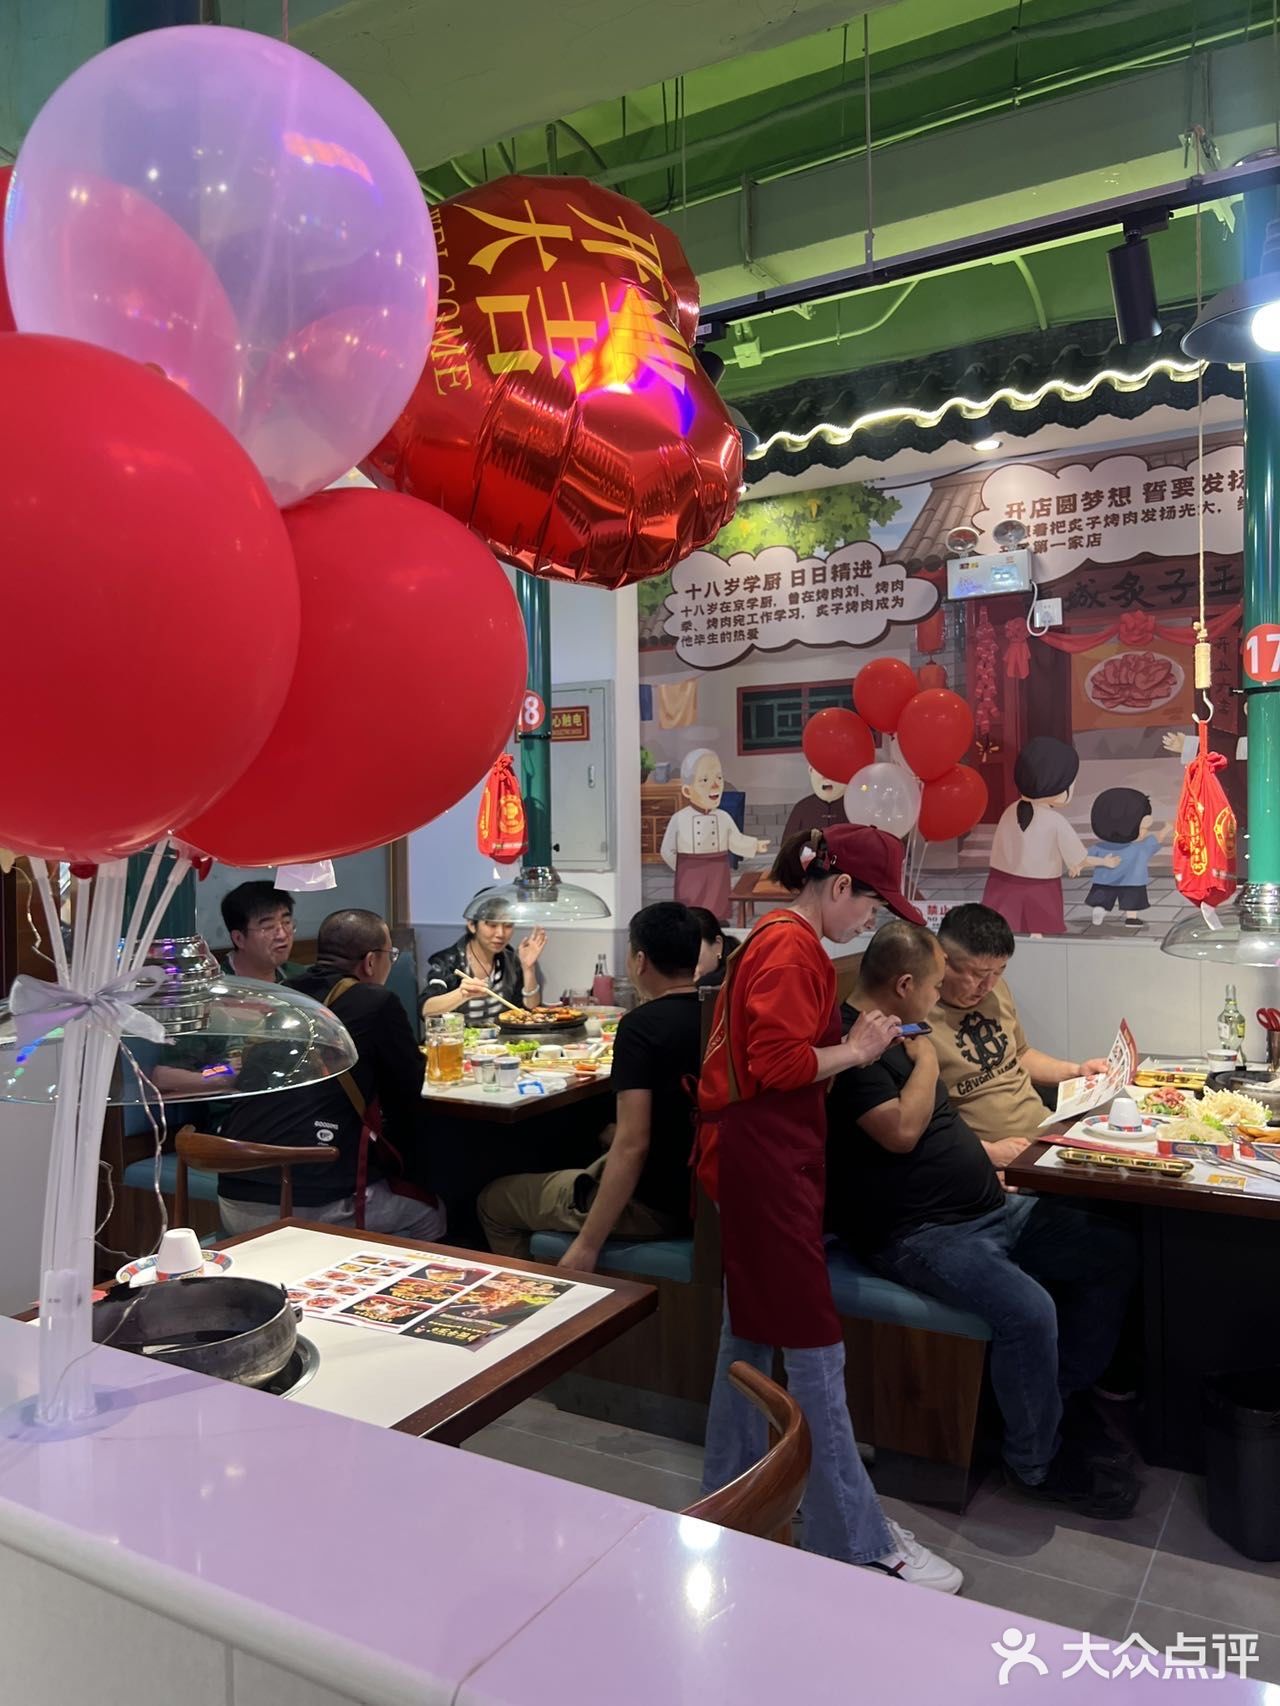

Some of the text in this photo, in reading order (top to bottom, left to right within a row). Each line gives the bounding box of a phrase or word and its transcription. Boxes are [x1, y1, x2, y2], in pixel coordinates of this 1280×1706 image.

[1004, 486, 1132, 520] 开店圆梦想
[685, 560, 873, 600] 十八岁学厨 日日精进
[681, 629, 759, 648] 他毕生的热爱
[1246, 634, 1280, 674] 17
[552, 713, 583, 728] 心触电
